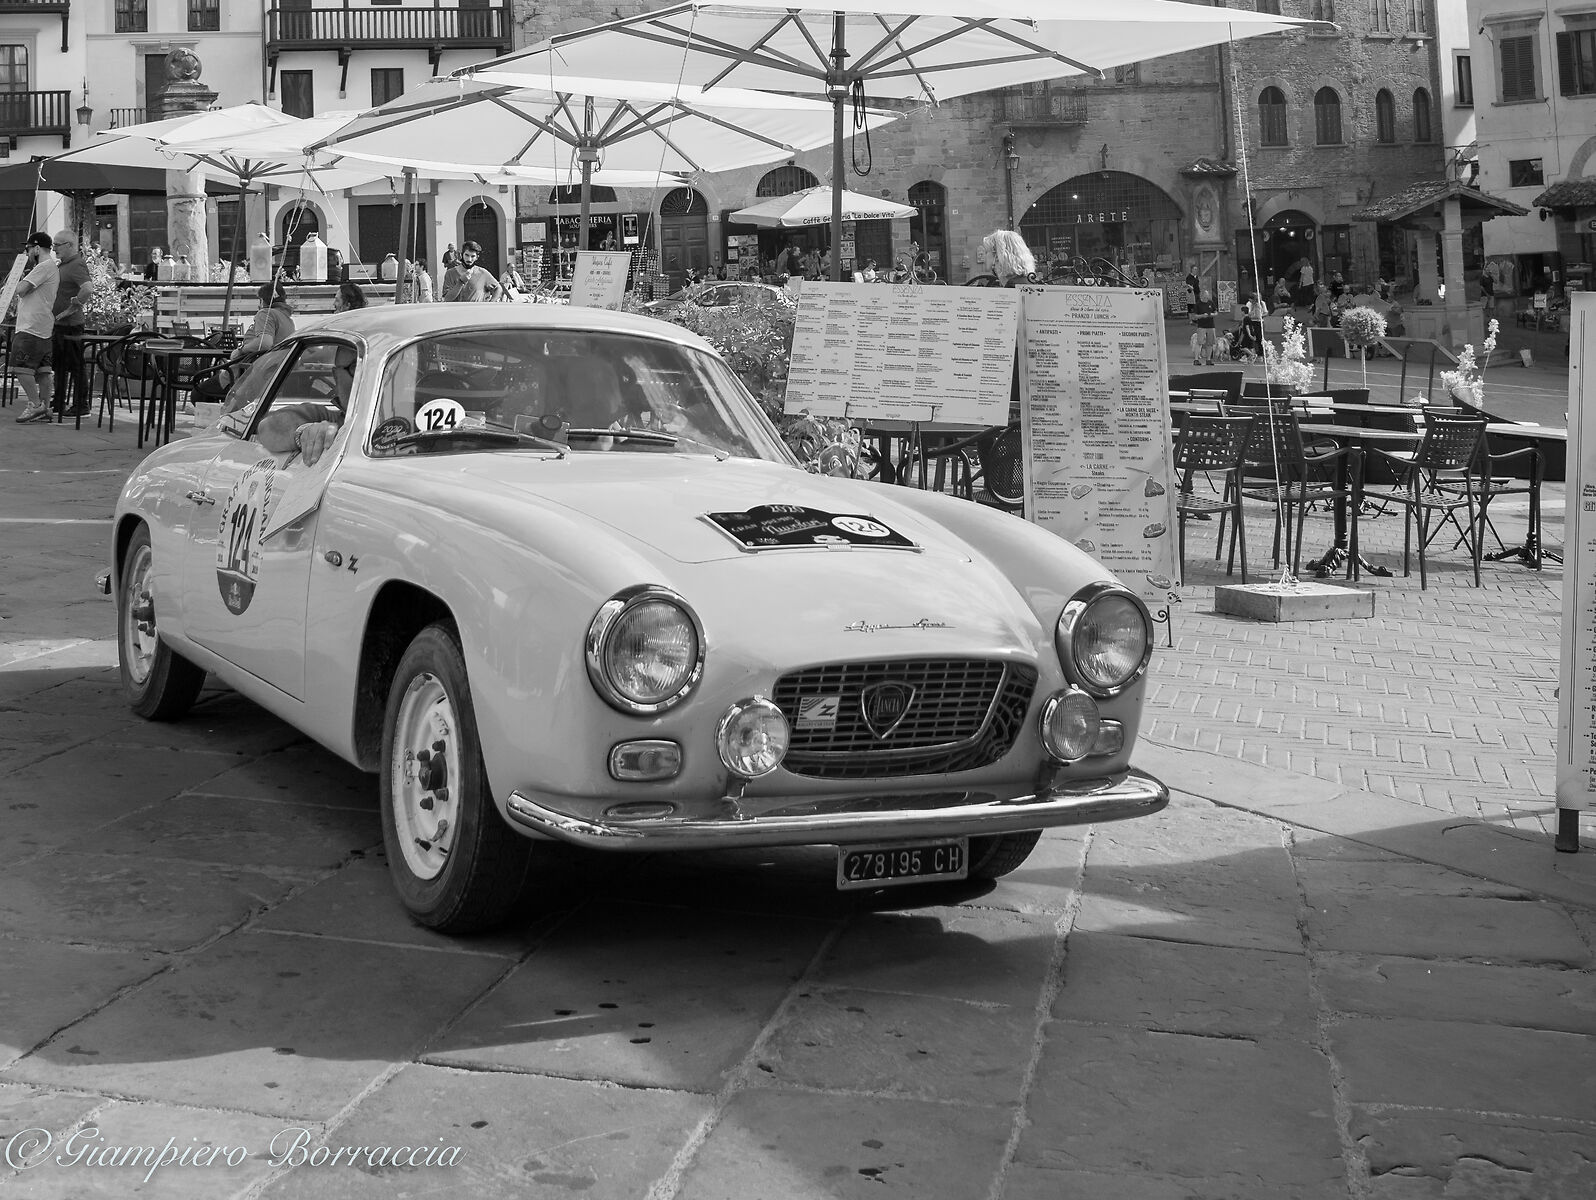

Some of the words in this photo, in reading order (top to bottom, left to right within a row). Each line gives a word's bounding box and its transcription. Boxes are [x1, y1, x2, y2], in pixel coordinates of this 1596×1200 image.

[553, 216, 613, 225] TABACHERIA
[863, 211, 880, 219] Dolce
[423, 408, 458, 431] 124
[837, 521, 886, 534] 124
[226, 503, 258, 573] 124
[850, 850, 922, 880] 278195
[934, 847, 960, 872] CH
